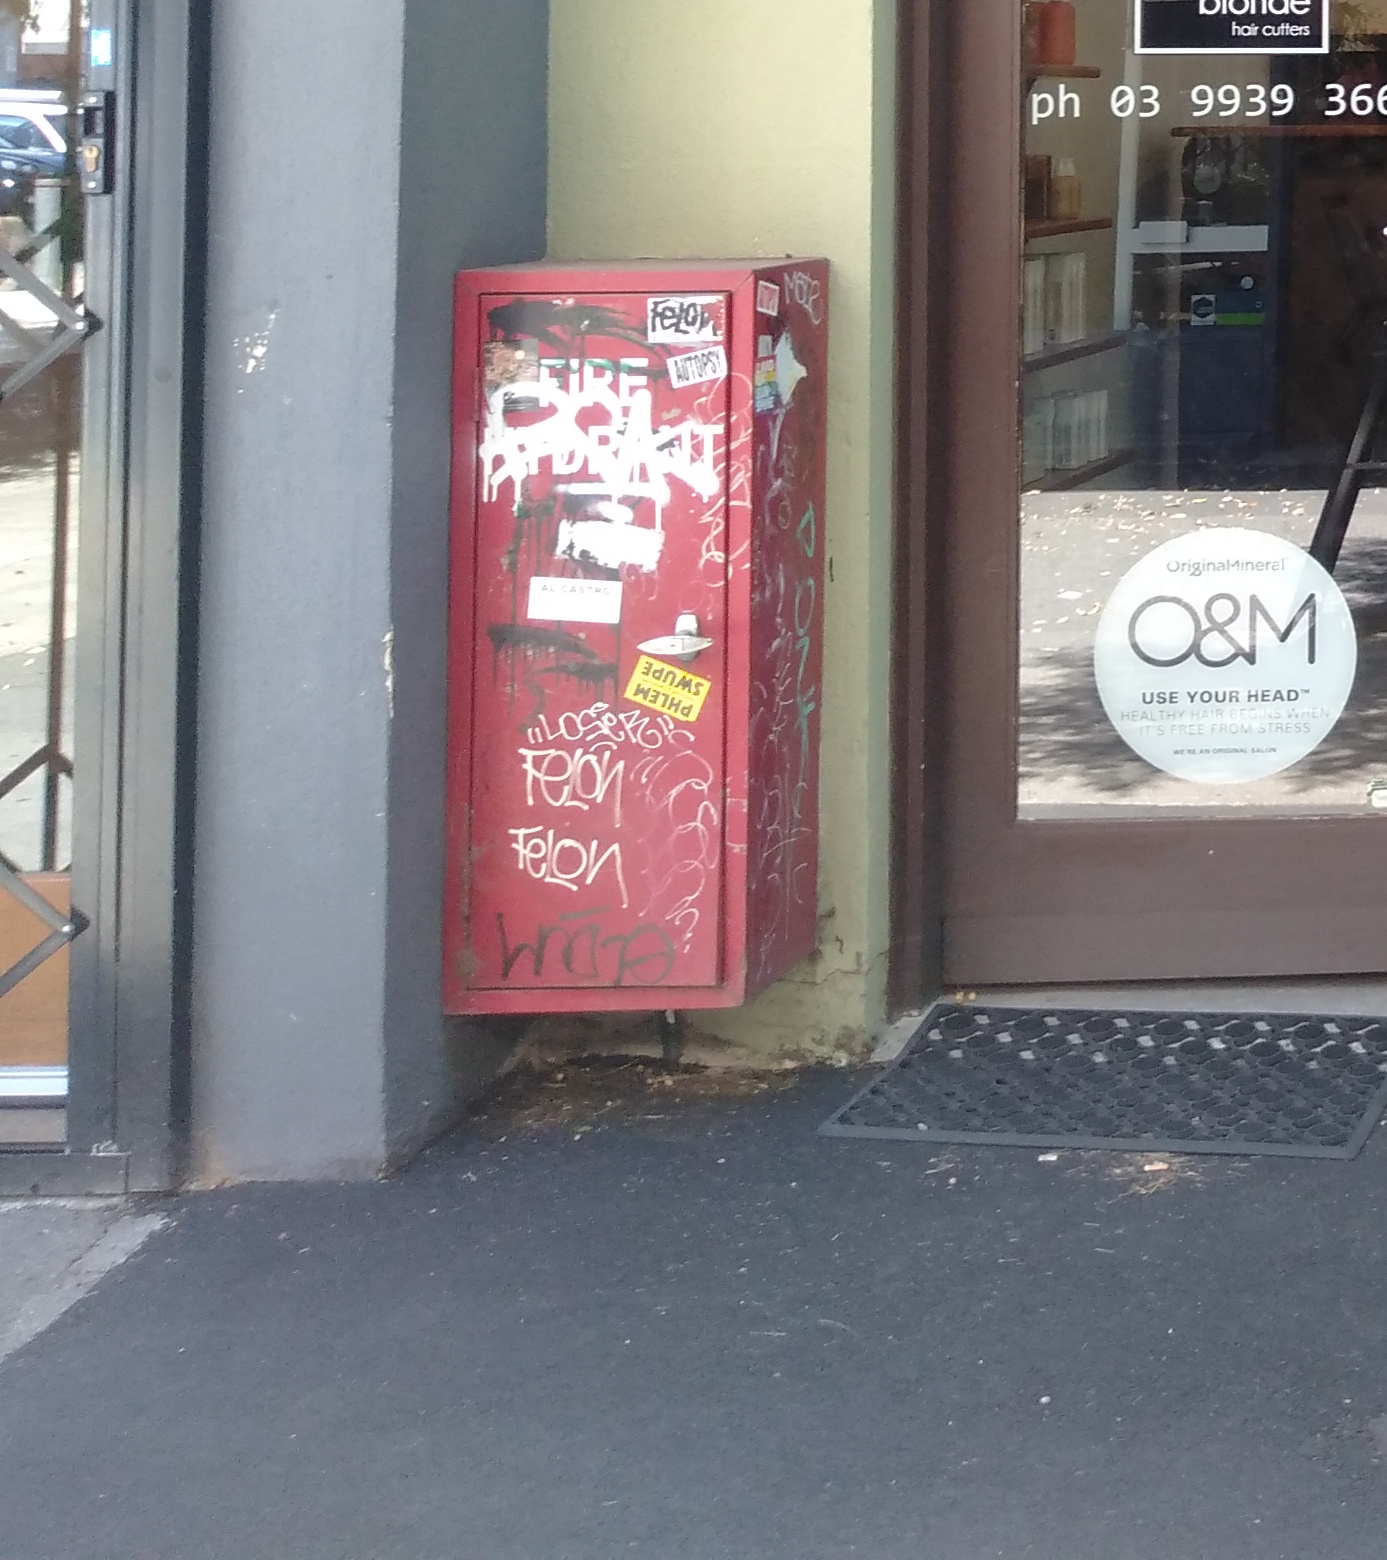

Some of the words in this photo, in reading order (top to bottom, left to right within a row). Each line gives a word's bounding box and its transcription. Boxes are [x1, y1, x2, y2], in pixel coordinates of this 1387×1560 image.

[1231, 21, 1259, 36] hair
[1262, 22, 1310, 36] cutters
[1030, 83, 1080, 125] ph
[1110, 85, 1160, 118] 03
[1190, 84, 1295, 118] 9939
[674, 349, 722, 383] AUTOPSY
[561, 585, 611, 595] CASTRO
[1127, 592, 1317, 668] O&M
[1142, 691, 1179, 704] USE
[1187, 690, 1240, 704] YOUR
[1121, 710, 1185, 722] HEALTHY
[1191, 709, 1224, 721] HAIR
[1229, 708, 1281, 720] BEGINS
[1287, 707, 1330, 719] WHEN
[1170, 724, 1205, 736] FREE
[1211, 723, 1253, 735] FROM
[1258, 722, 1311, 734] STRESS
[1199, 747, 1210, 755] AN
[1212, 746, 1247, 755] ORIGINAL
[1251, 746, 1277, 754] SALON
